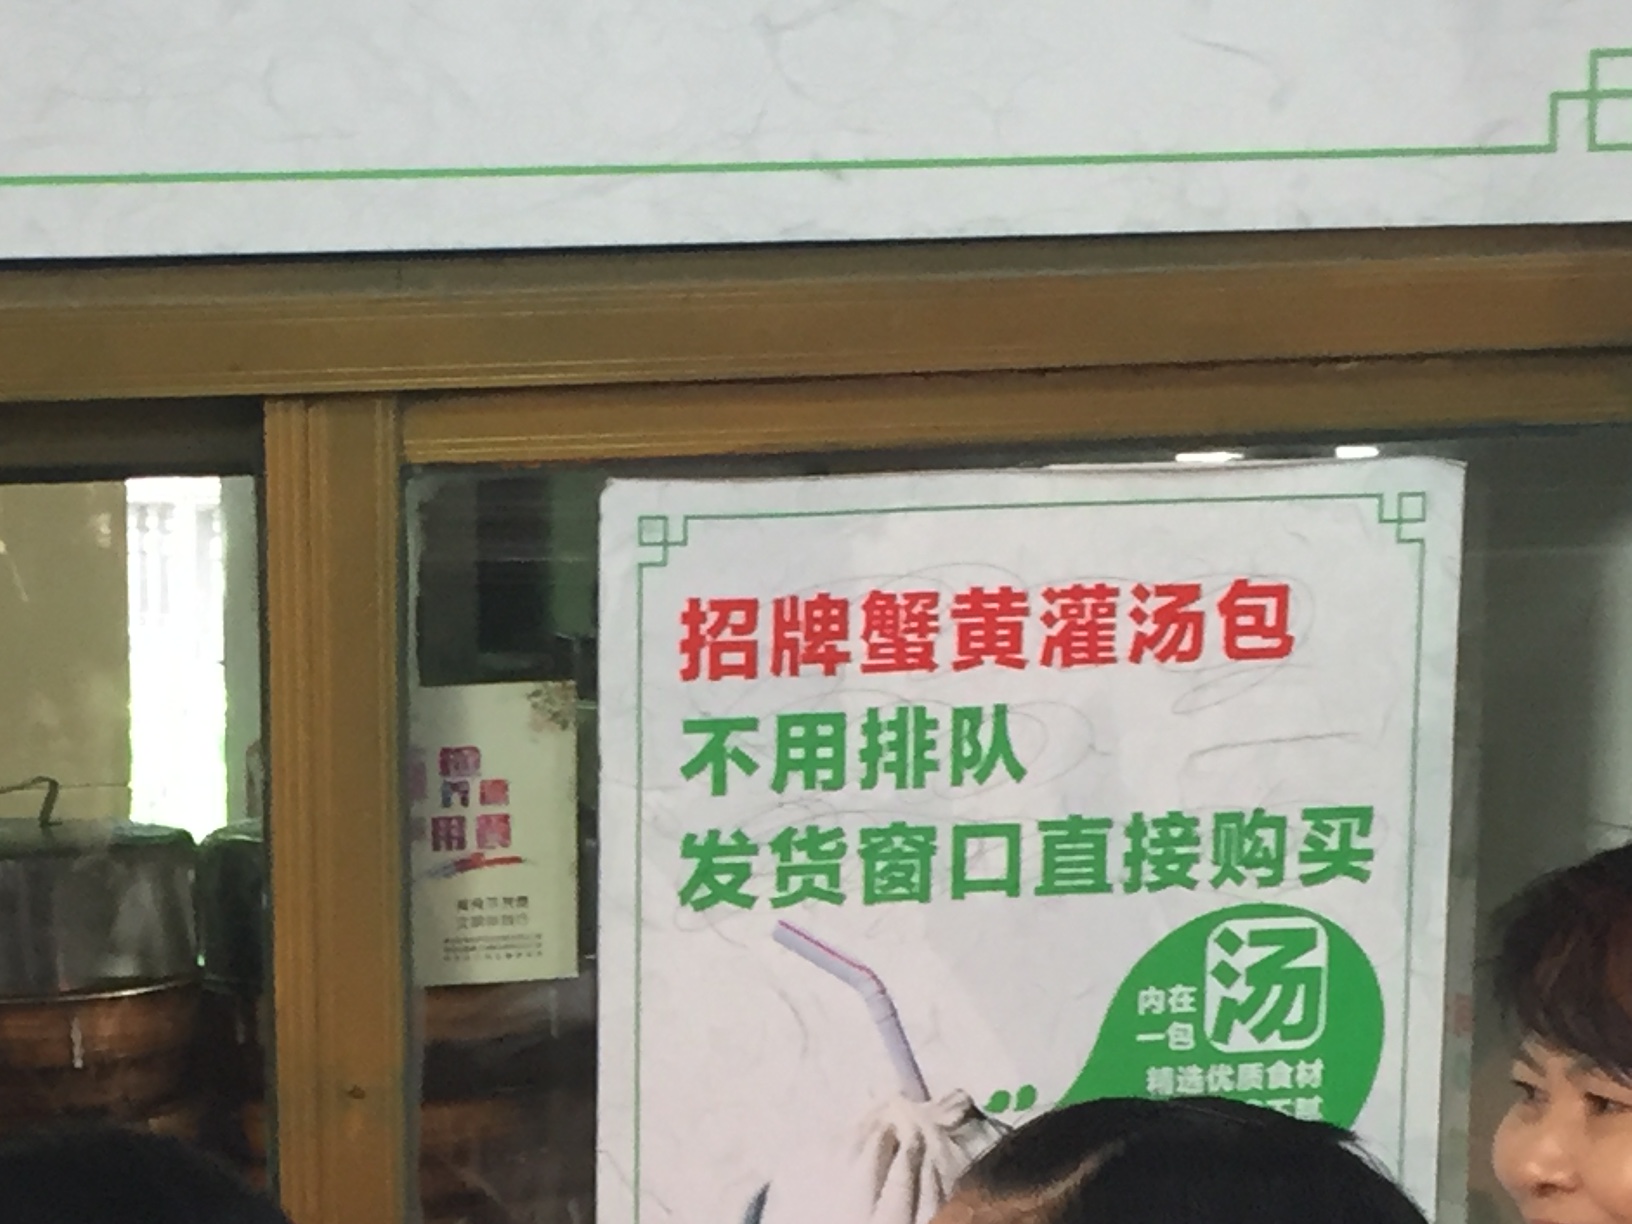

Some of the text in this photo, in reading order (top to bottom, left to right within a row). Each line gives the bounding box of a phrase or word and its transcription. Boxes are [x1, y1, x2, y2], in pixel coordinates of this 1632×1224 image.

[677, 577, 1296, 682] 招牌蟹黄灌汤包
[679, 703, 1028, 797] 不用排队
[677, 804, 1376, 912] 发货窗口直接购买
[1135, 1021, 1196, 1051] 一包
[1206, 918, 1327, 1050] 汤
